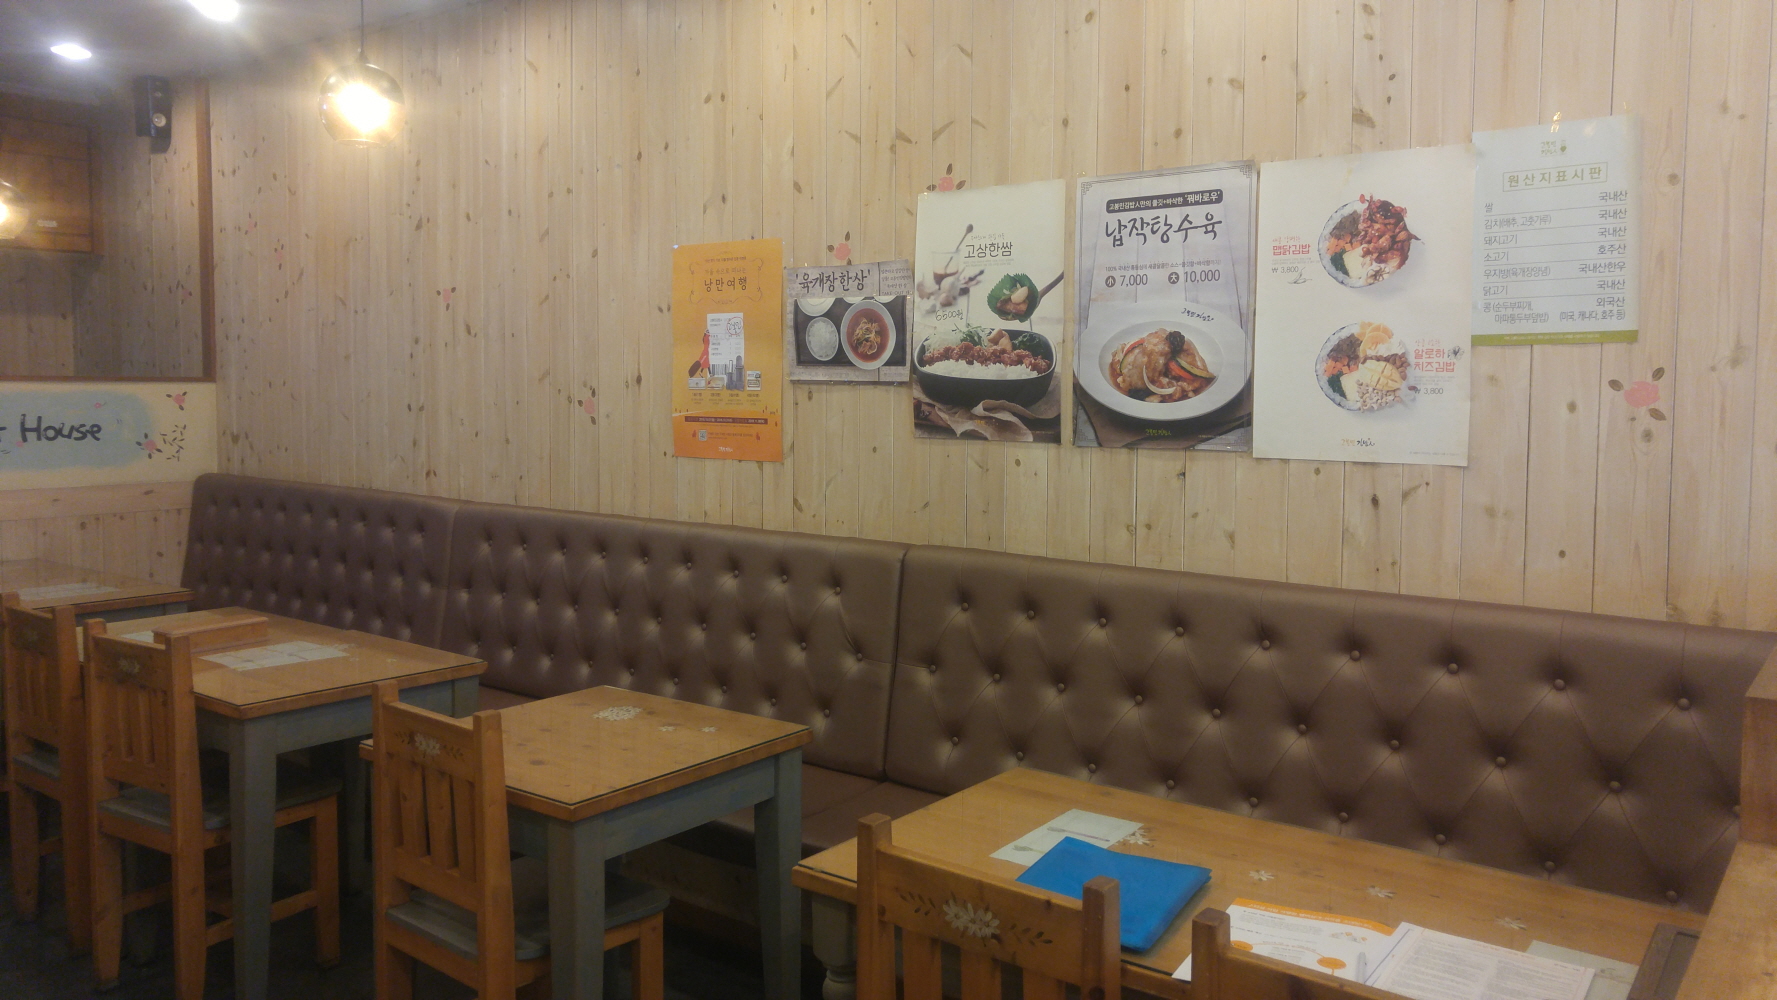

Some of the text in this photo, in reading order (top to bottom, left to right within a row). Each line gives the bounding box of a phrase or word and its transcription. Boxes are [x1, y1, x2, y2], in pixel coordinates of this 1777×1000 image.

[1485, 190, 1628, 213] 쌀 국내산
[1599, 208, 1627, 220] 국내산
[1106, 212, 1223, 248] 납작탕수육
[1484, 226, 1627, 246] 돼지고기 국내산
[964, 241, 1014, 259] 고상한쌈
[1272, 244, 1311, 256] 맵닭김밥
[1484, 244, 1626, 262] 소고기 호주산
[1579, 261, 1626, 274] 국내산한우
[1120, 274, 1149, 287] 7,000
[1169, 272, 1179, 284] 大
[1184, 269, 1221, 284] 10,000
[1483, 279, 1626, 296] 닭고기 국내산
[1483, 302, 1492, 313] 콩
[1596, 296, 1626, 308] 외국산
[1560, 311, 1577, 322] (미국,
[1578, 311, 1600, 321] 캐나다,
[1601, 310, 1614, 320] 호주
[1414, 348, 1445, 360] 알로하
[1414, 361, 1456, 373] 치즈김밥
[1424, 387, 1444, 395] 3,800
[20, 413, 102, 443] House
